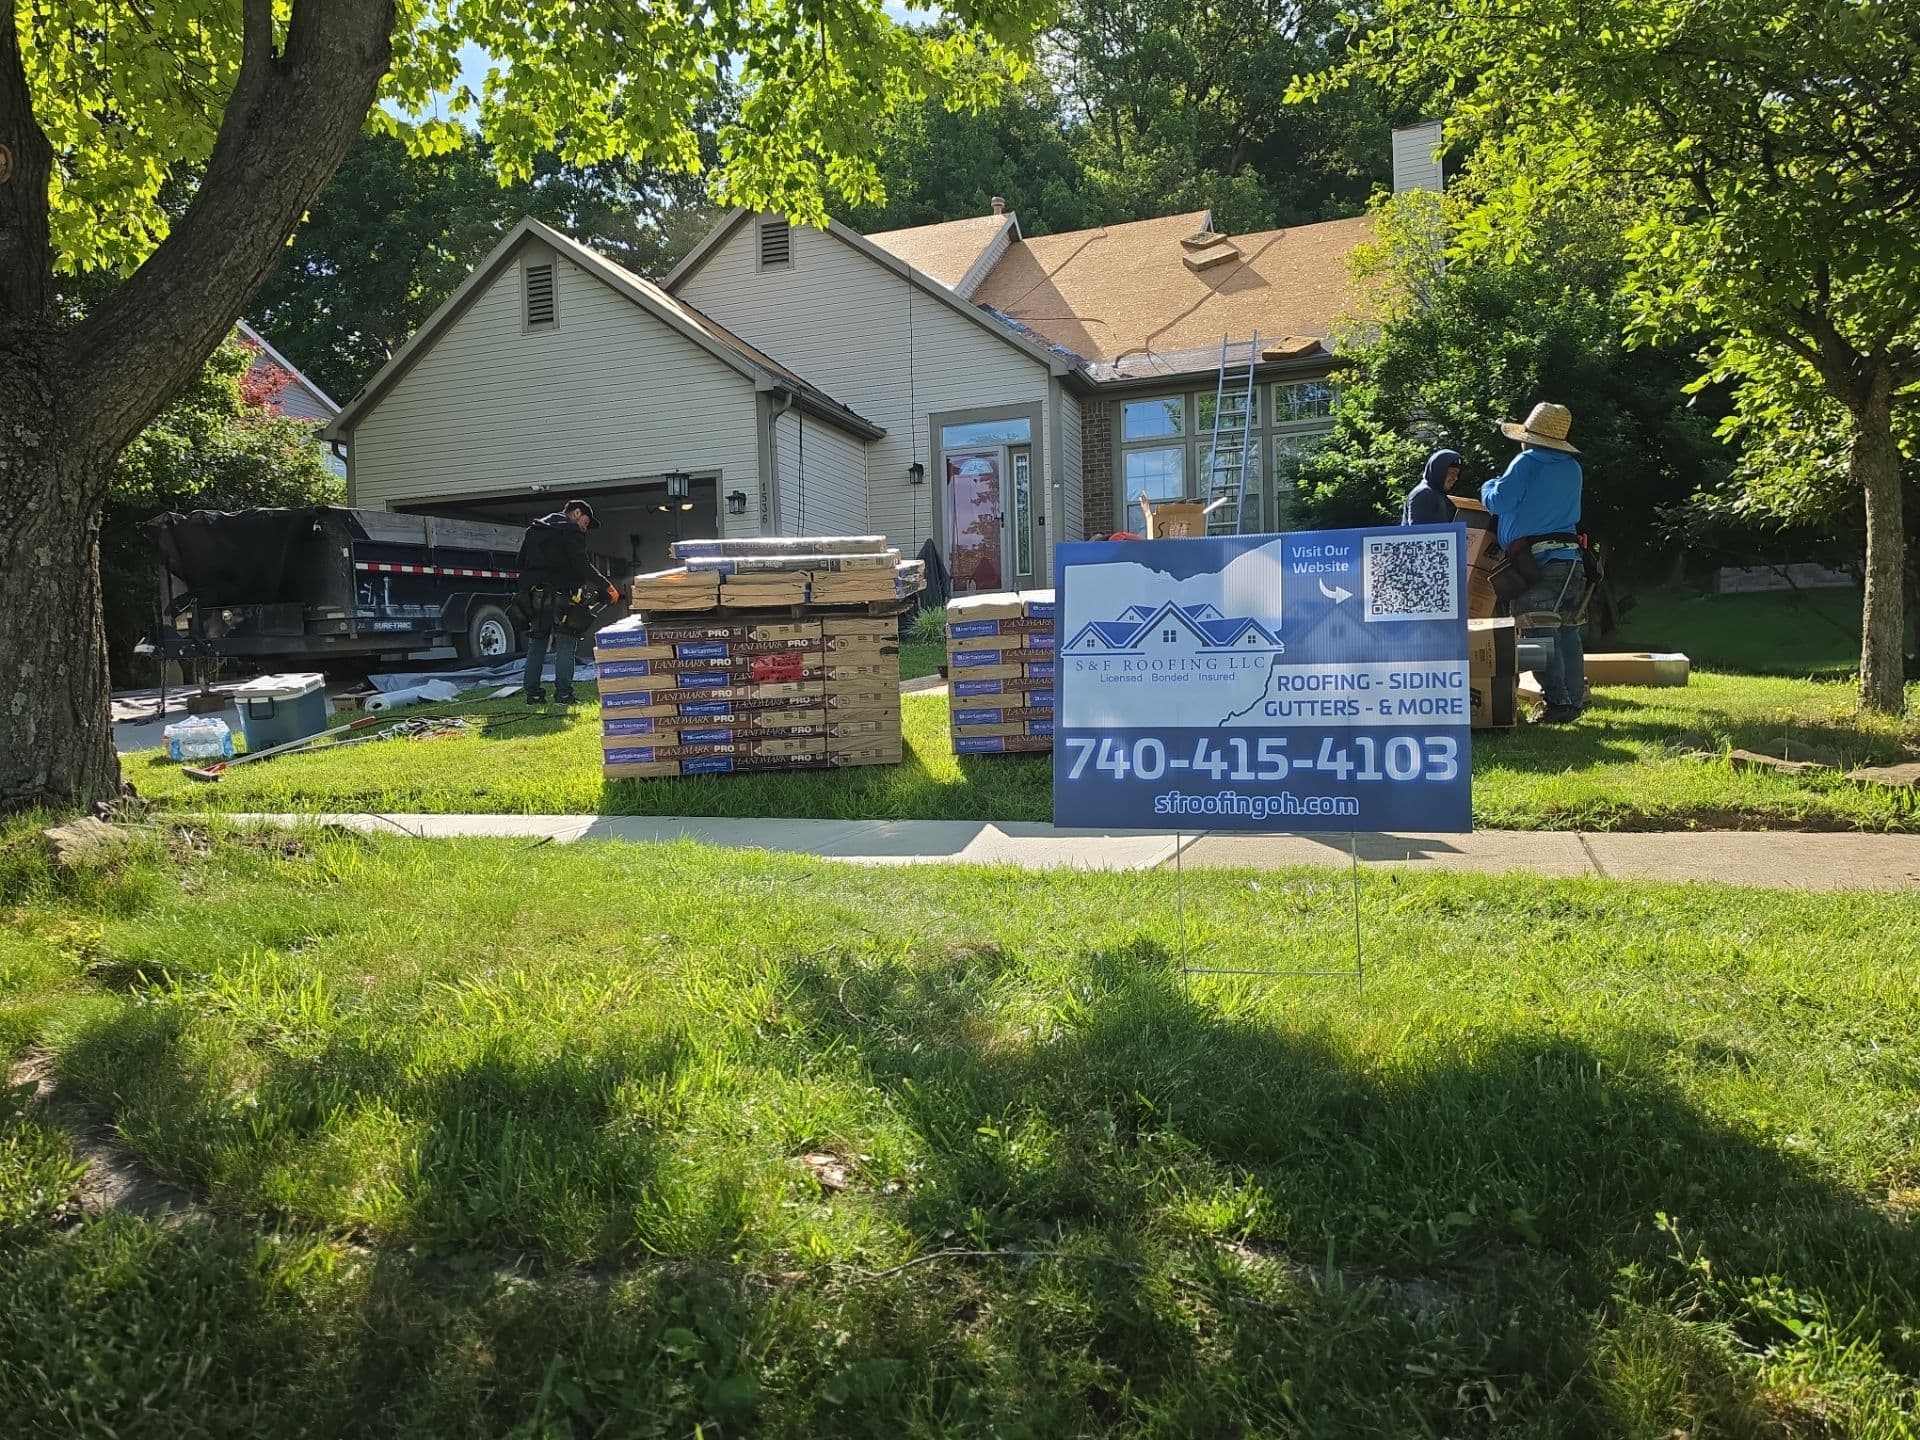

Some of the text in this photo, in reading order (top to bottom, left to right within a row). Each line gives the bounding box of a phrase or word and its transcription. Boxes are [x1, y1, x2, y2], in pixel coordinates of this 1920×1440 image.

[1293, 545, 1349, 558] Visit Our
[739, 560, 763, 568] Shadow
[765, 560, 783, 568] Ridge
[1293, 561, 1349, 574] Website
[652, 631, 704, 640] LANDMARK
[707, 629, 729, 637] PRO
[733, 641, 784, 650] LANDMARK
[788, 640, 808, 648] PRO
[654, 660, 706, 669] LANDMARK
[710, 658, 731, 667] PRO
[1075, 656, 1265, 672] S&F ROOFING LLC
[1100, 672, 1235, 683] Licensed Bonded Insured
[1277, 673, 1370, 691] ROOFING
[1389, 671, 1462, 690] SIDING
[656, 691, 708, 701] LANDMARK
[712, 690, 733, 698] PRO
[1264, 699, 1360, 717] GUTTERS
[1379, 699, 1392, 715] &
[1398, 698, 1463, 715] MORE
[658, 716, 711, 725] LANDMARK
[714, 714, 734, 722] PRO
[659, 746, 711, 756] LANDMARK
[714, 745, 735, 753] PRO
[791, 754, 812, 762] PRO
[1065, 736, 1458, 781] 740-415-4103
[1154, 790, 1359, 820] sfroofingoh.com
